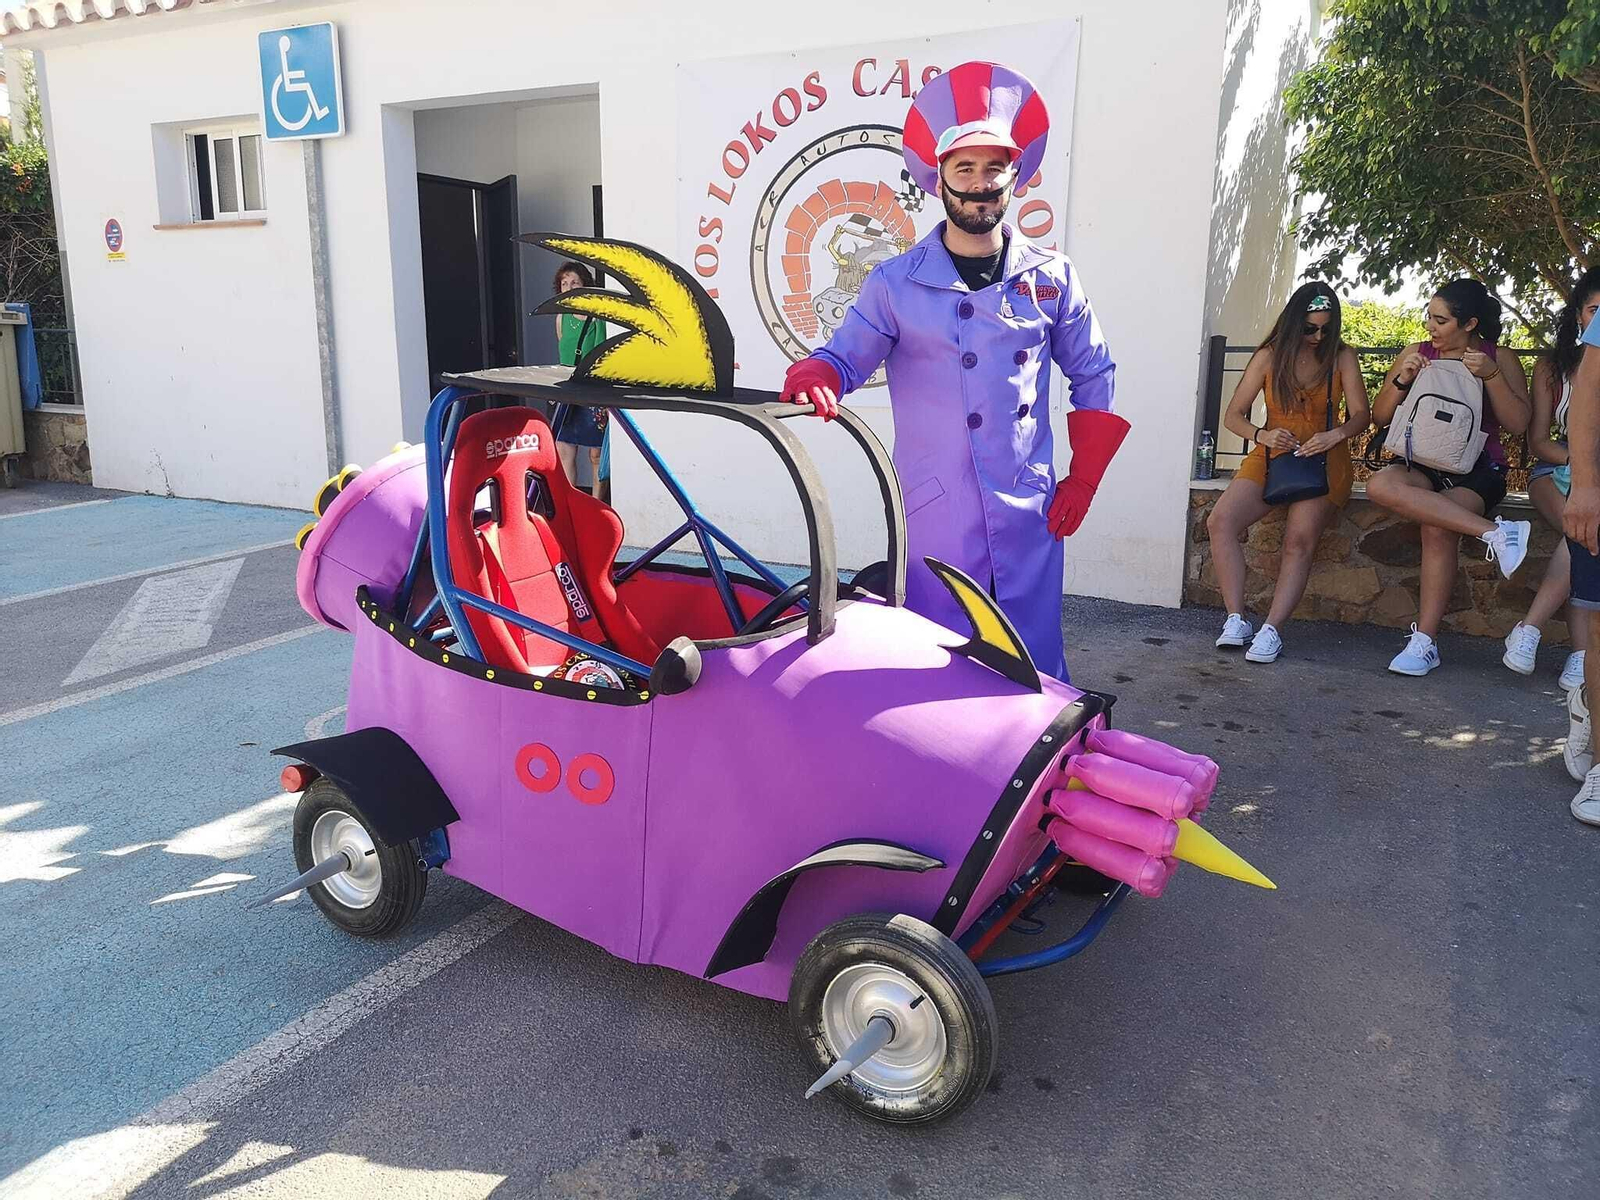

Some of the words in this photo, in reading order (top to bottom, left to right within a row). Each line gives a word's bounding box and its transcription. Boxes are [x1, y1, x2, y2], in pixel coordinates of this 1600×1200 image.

[707, 70, 828, 206] LOKOS
[800, 131, 896, 167] AUTOS
[486, 434, 539, 458] sparco
[559, 567, 587, 618] sparco
